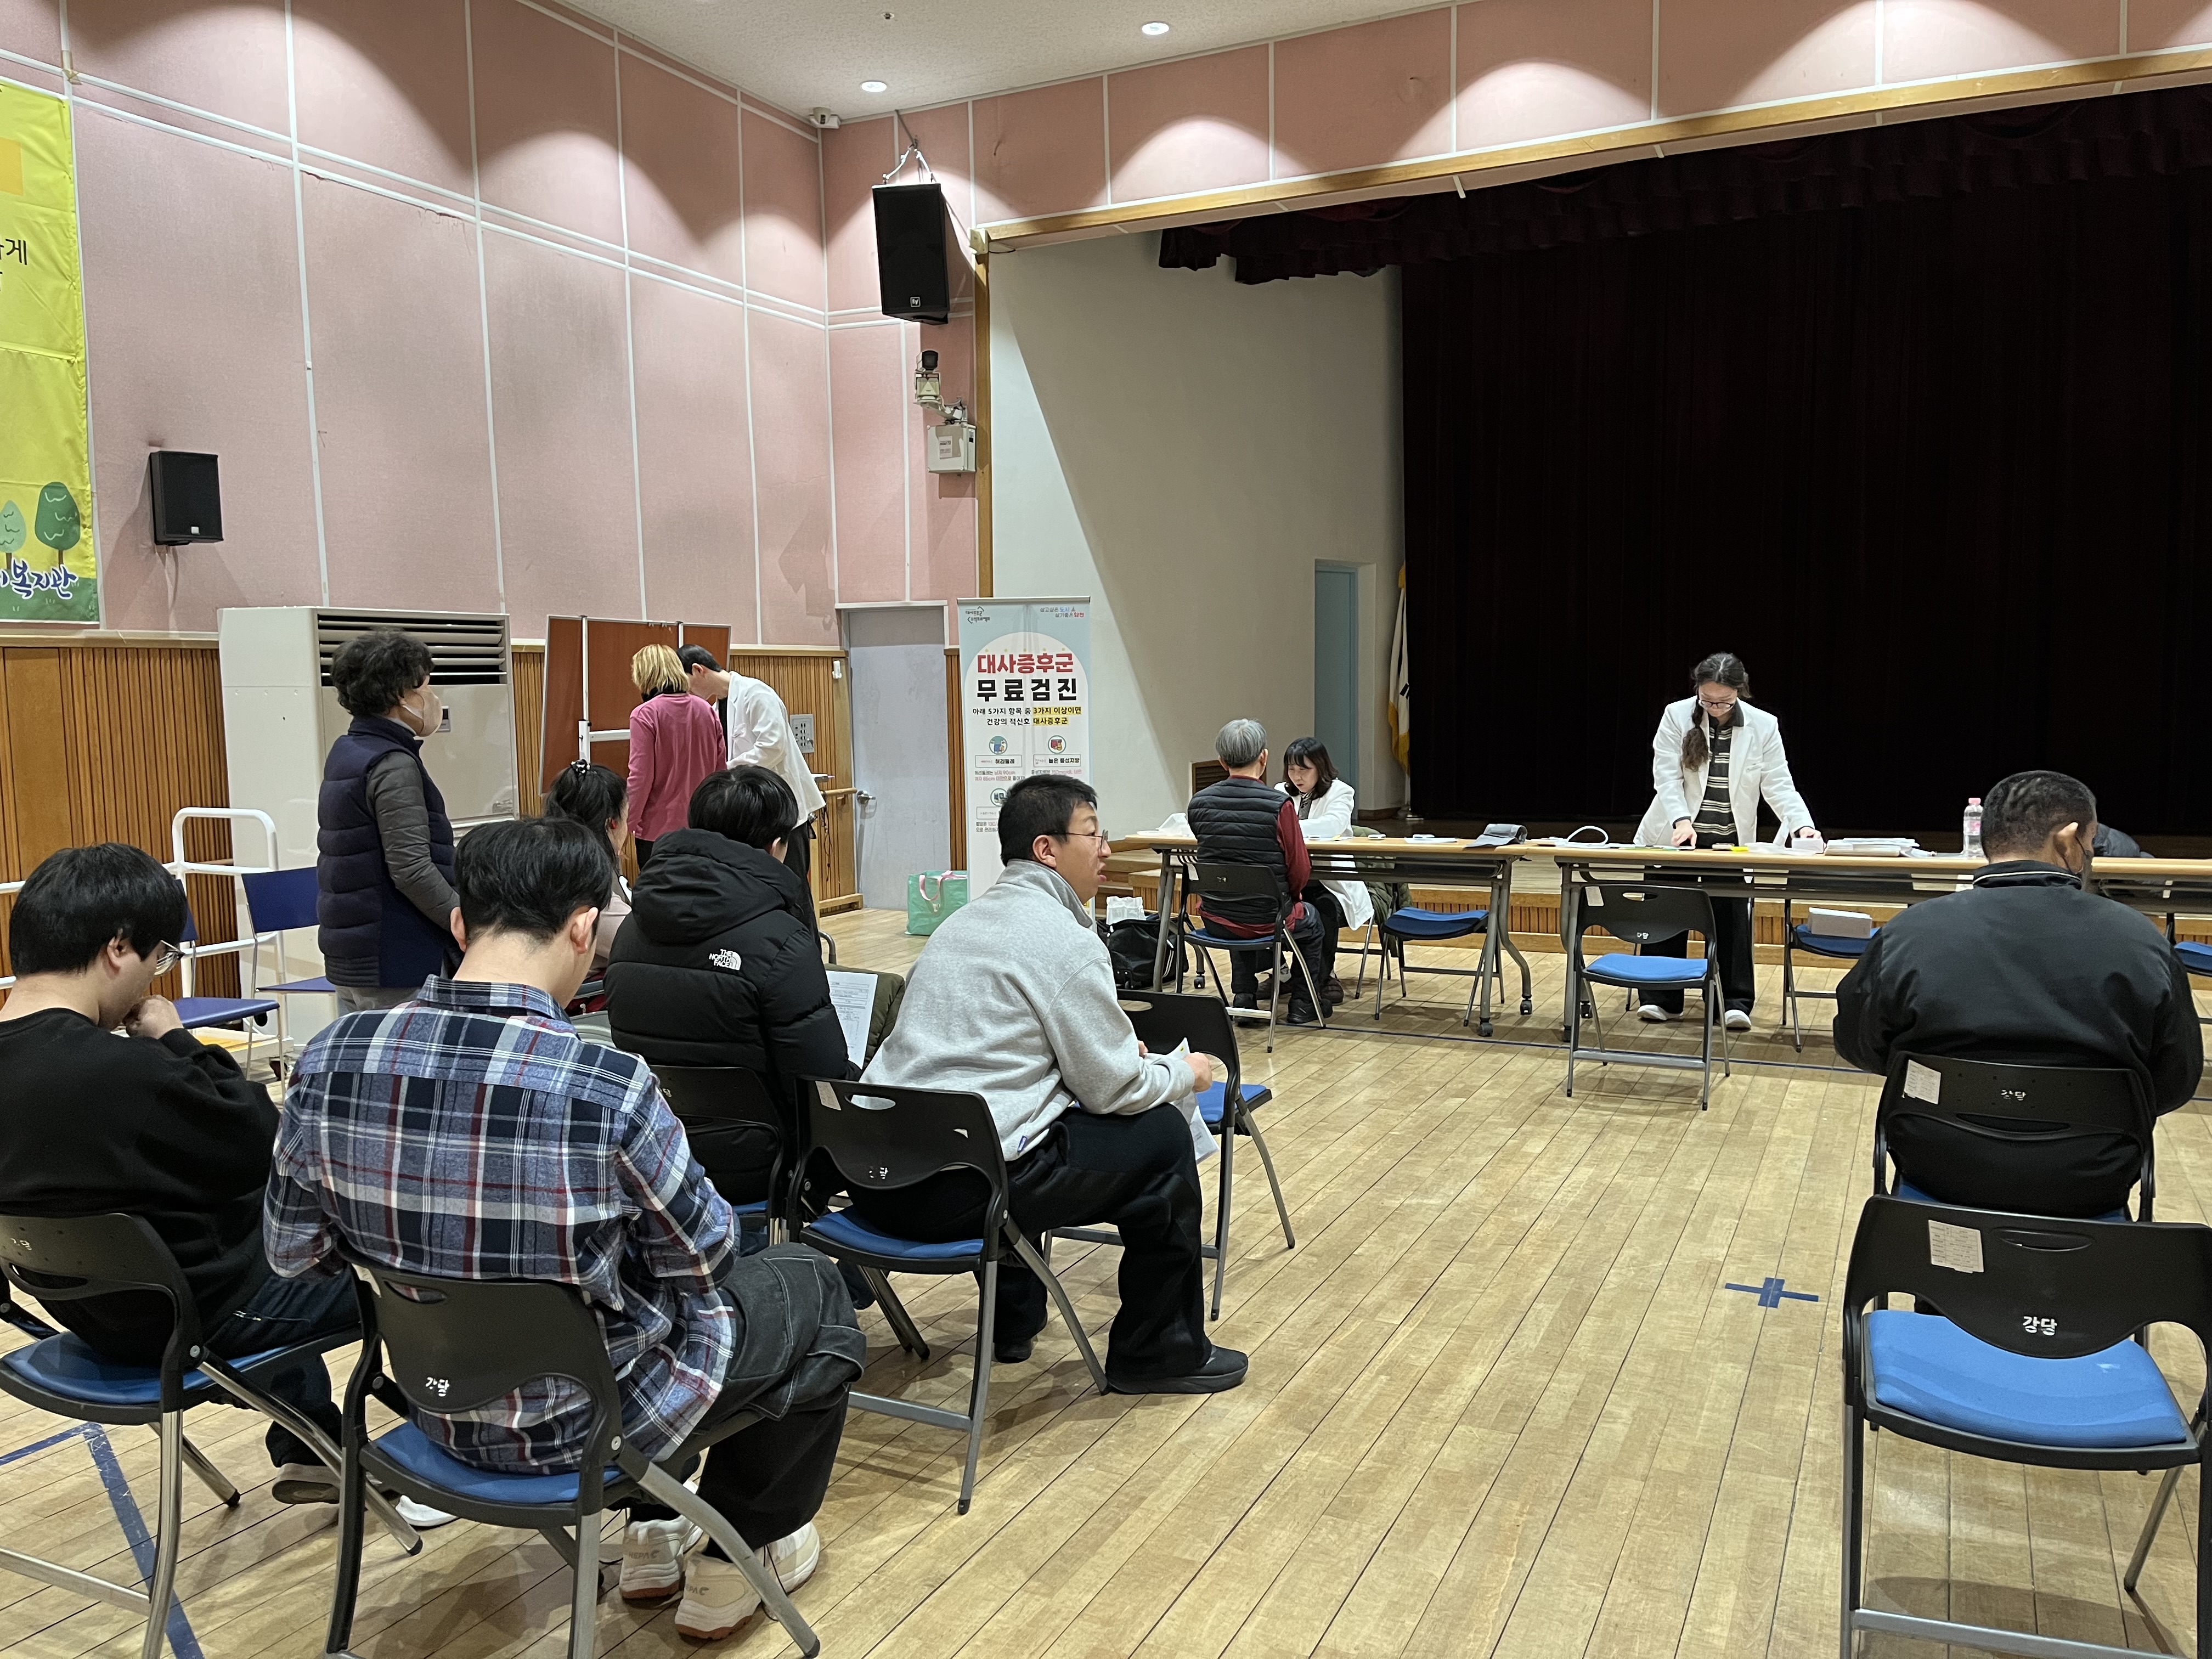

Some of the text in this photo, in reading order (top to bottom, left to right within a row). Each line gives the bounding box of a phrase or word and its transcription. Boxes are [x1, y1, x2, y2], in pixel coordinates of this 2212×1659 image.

[0, 239, 27, 266] 게
[977, 652, 1074, 674] 대사증후군
[1053, 706, 1082, 714] 이상이면
[1032, 716, 1068, 725] 대사증후군
[720, 948, 733, 956] THE
[708, 953, 731, 963] NORTH
[713, 959, 730, 968] FACE
[2022, 1315, 2058, 1336] 강당
